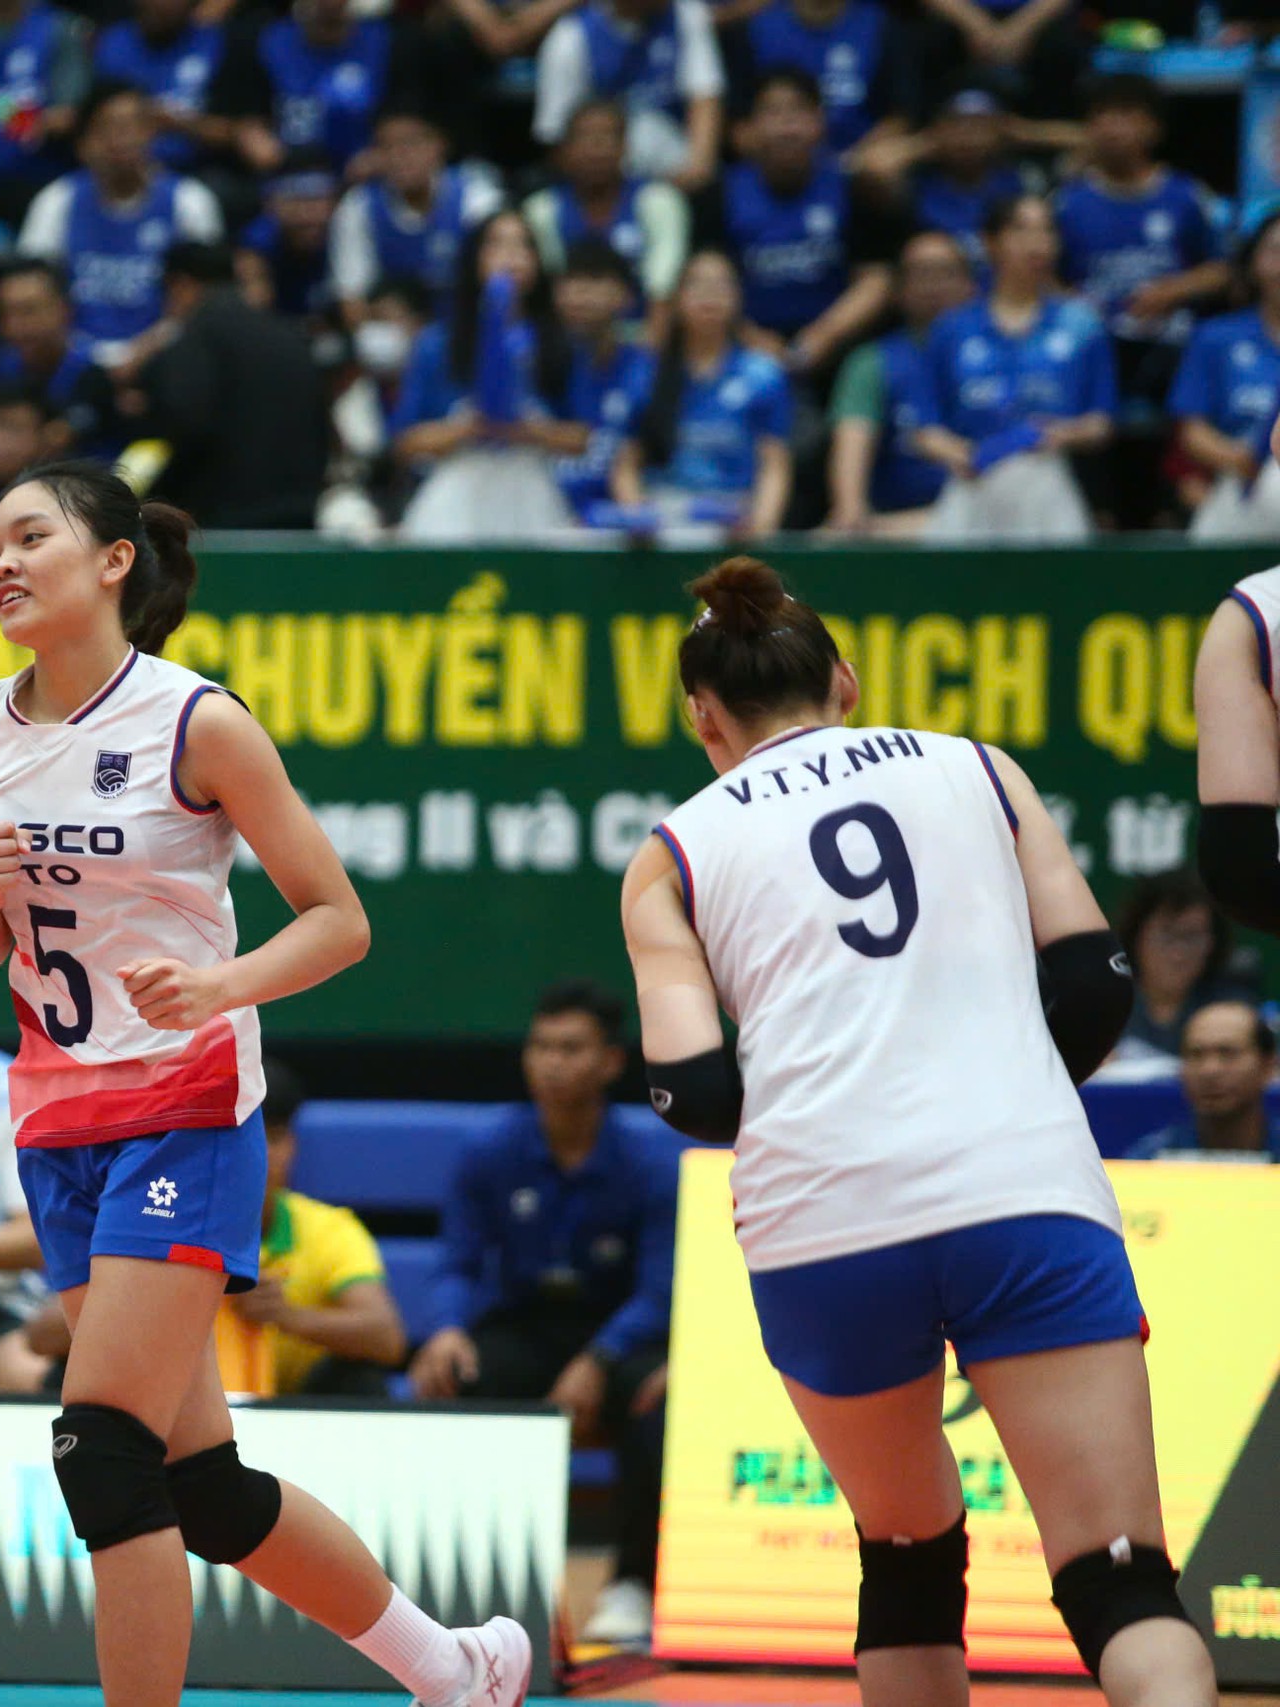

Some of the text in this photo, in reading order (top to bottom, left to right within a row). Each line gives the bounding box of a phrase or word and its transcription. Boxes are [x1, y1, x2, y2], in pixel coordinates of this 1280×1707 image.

[723, 726, 925, 806] V.T.Y.NHI
[808, 801, 919, 958] 9
[29, 903, 93, 1048] 5
